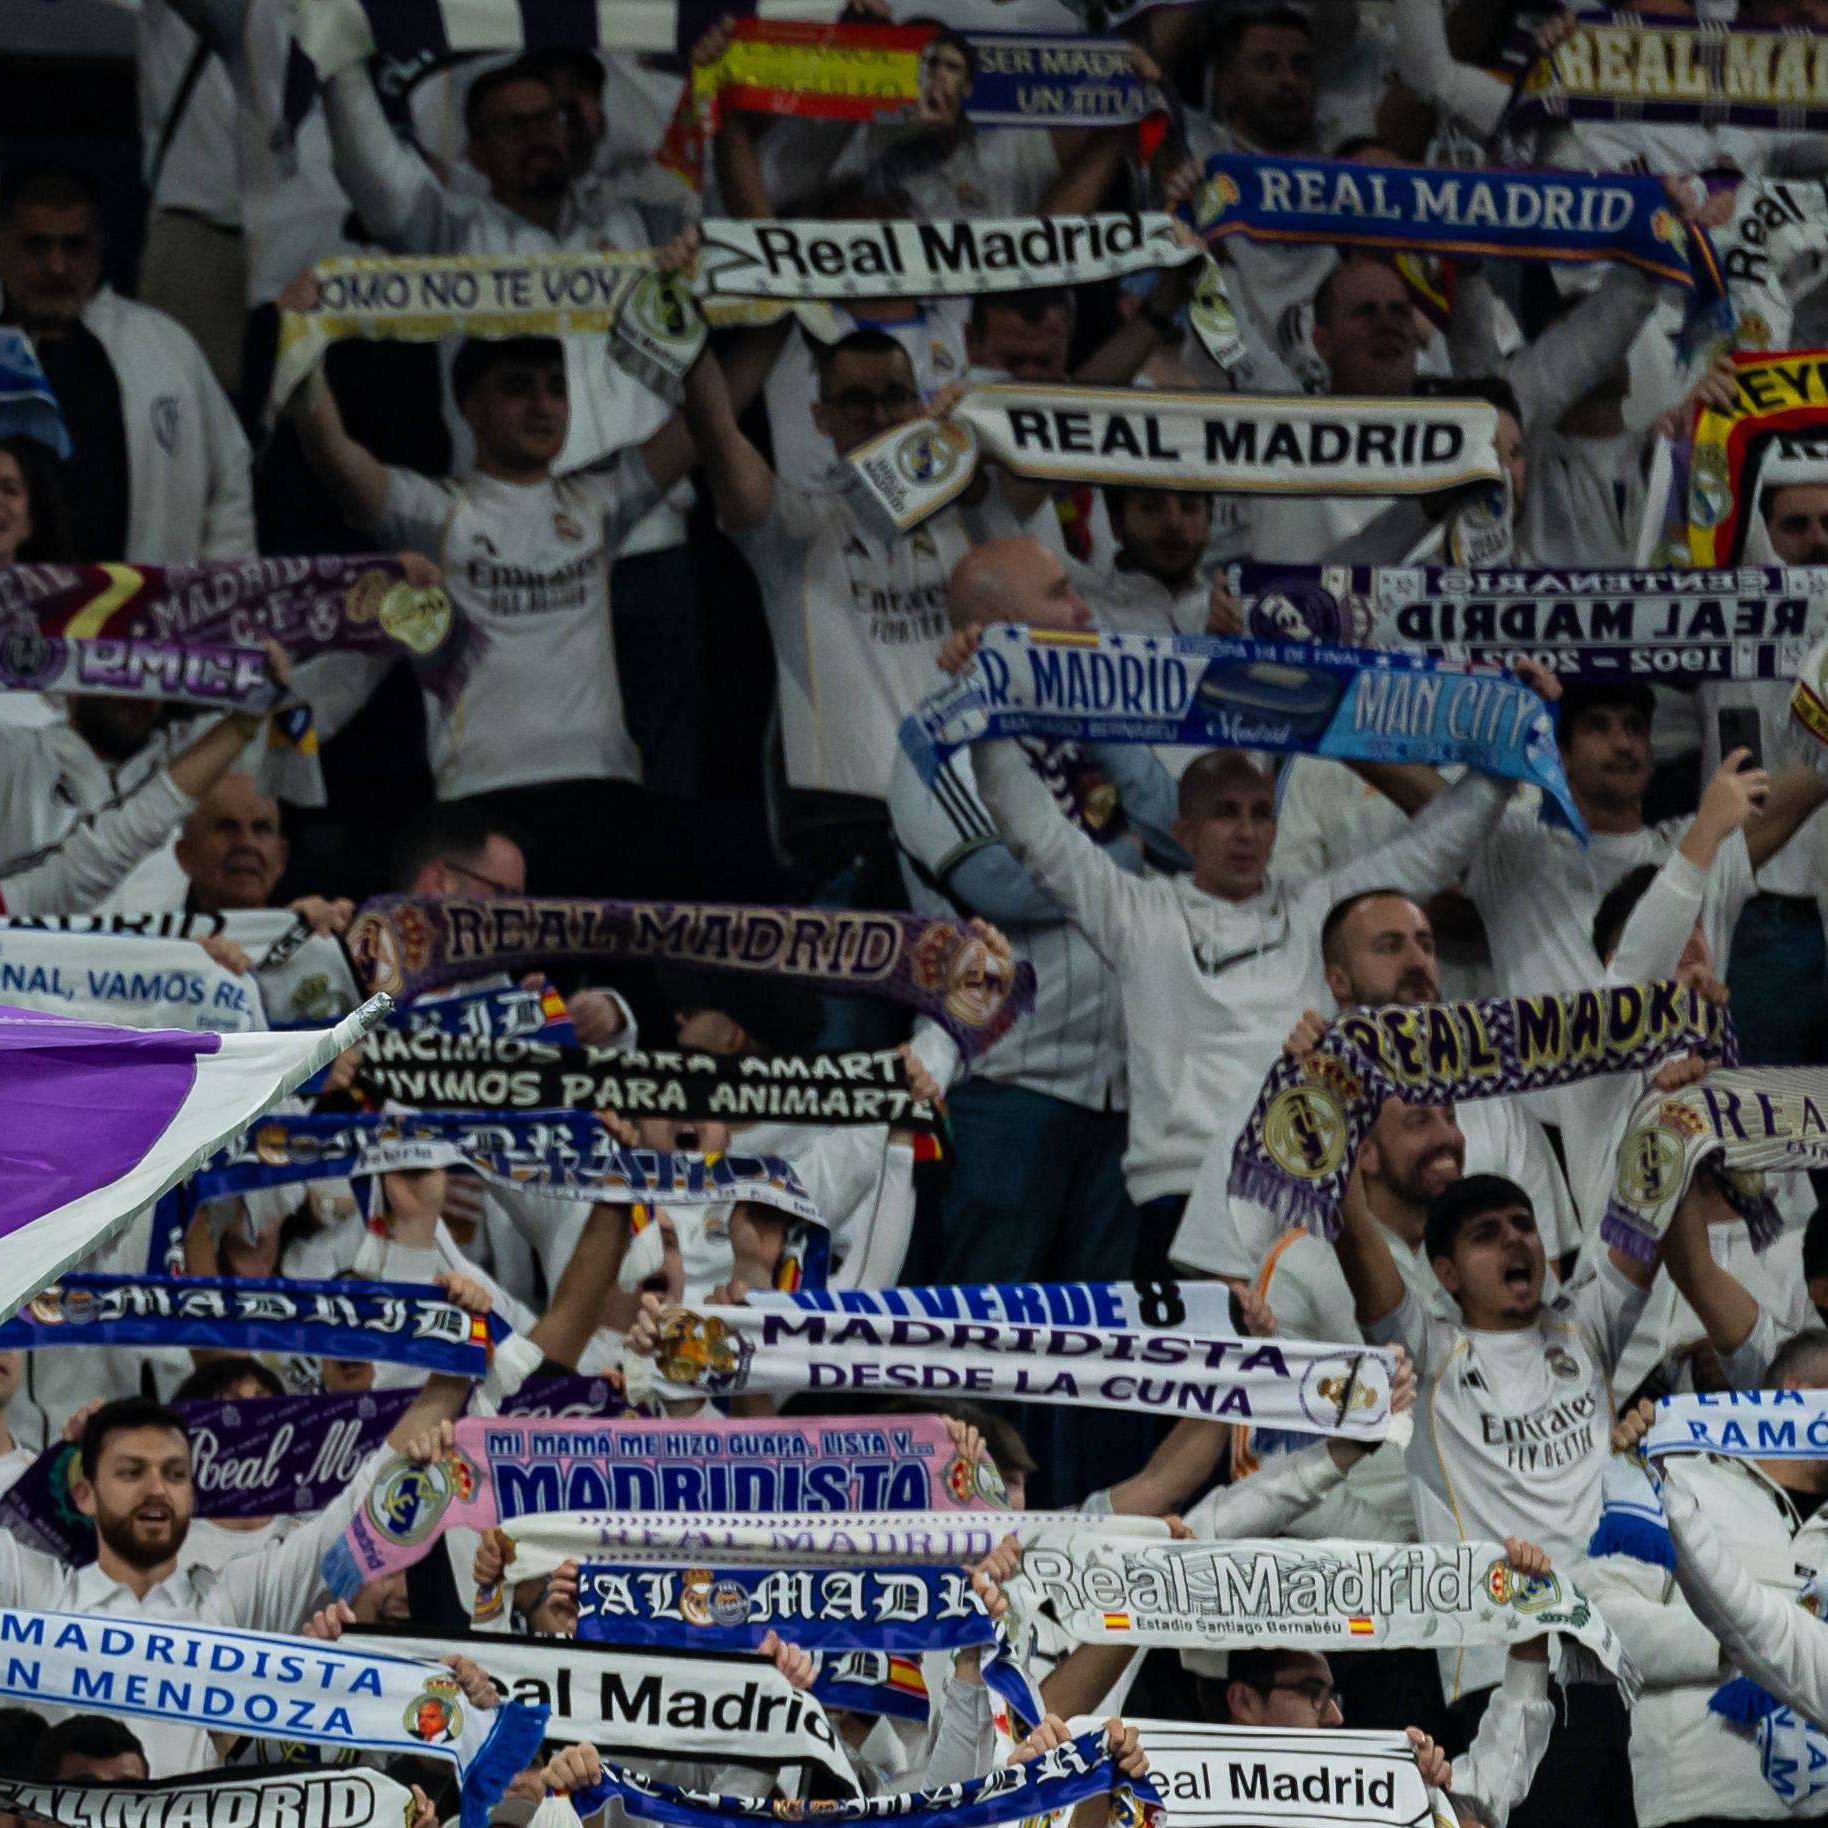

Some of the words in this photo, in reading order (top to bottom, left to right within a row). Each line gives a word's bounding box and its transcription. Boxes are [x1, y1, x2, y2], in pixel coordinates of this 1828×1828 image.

[1260, 165, 1405, 222] REAL
[1413, 178, 1637, 234] MADRID
[756, 226, 903, 278] Real
[925, 210, 1143, 272] Madrid
[1010, 408, 1183, 462] REAL
[1205, 420, 1465, 466] MADRID
[1031, 645, 1193, 715] MADRID
[1353, 668, 1443, 740] MAN
[1446, 675, 1540, 750] CITY
[443, 902, 623, 962] REAL
[638, 905, 905, 985] MADRID
[88, 968, 206, 1005] VAMOS
[561, 1073, 691, 1112] PARA
[761, 1312, 1291, 1378] MADRIDISTA
[808, 1360, 998, 1396] DESDE
[1016, 1369, 1078, 1402] LA
[1099, 1376, 1254, 1418] CUNA
[489, 1430, 525, 1457] MI
[534, 1428, 612, 1457] MAMÁ
[620, 1430, 660, 1456] ME
[666, 1429, 720, 1456] HIZO
[490, 1460, 931, 1520] MADRIDISTA
[1021, 1550, 1190, 1615] Real
[1207, 1546, 1474, 1617] Madrid
[0, 1612, 385, 1699] MADRIDISTA
[1196, 1614, 1266, 1640] Santiago
[1266, 1615, 1343, 1637] Bernabéu
[71, 1665, 356, 1738] MENDOZA
[600, 1670, 838, 1748] Madrid
[1227, 1760, 1397, 1812] Madrid
